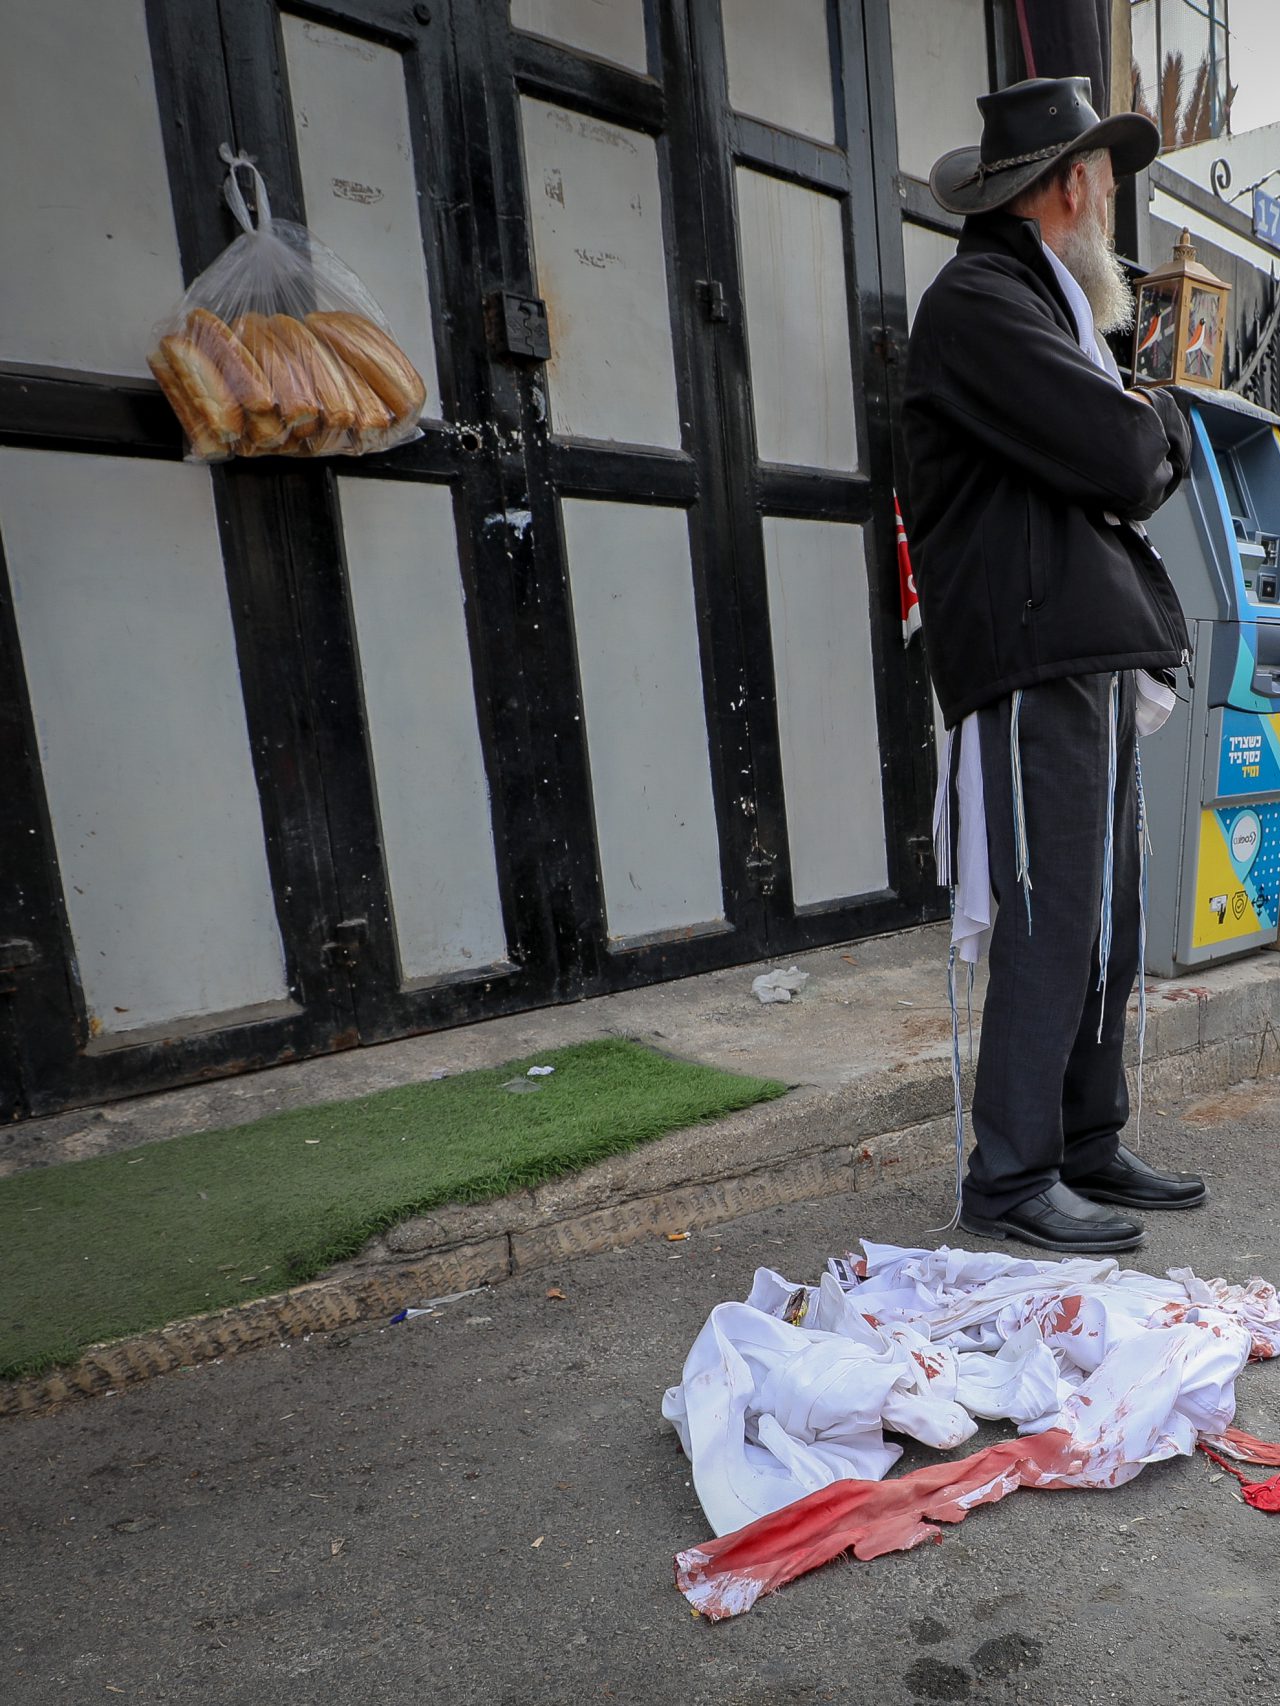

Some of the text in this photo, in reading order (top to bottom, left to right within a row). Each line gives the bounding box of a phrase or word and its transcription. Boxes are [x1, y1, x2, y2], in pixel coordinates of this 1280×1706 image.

[1258, 199, 1280, 237] 17
[1229, 735, 1262, 751] כשצריך
[1229, 750, 1261, 765] כסף ביד
